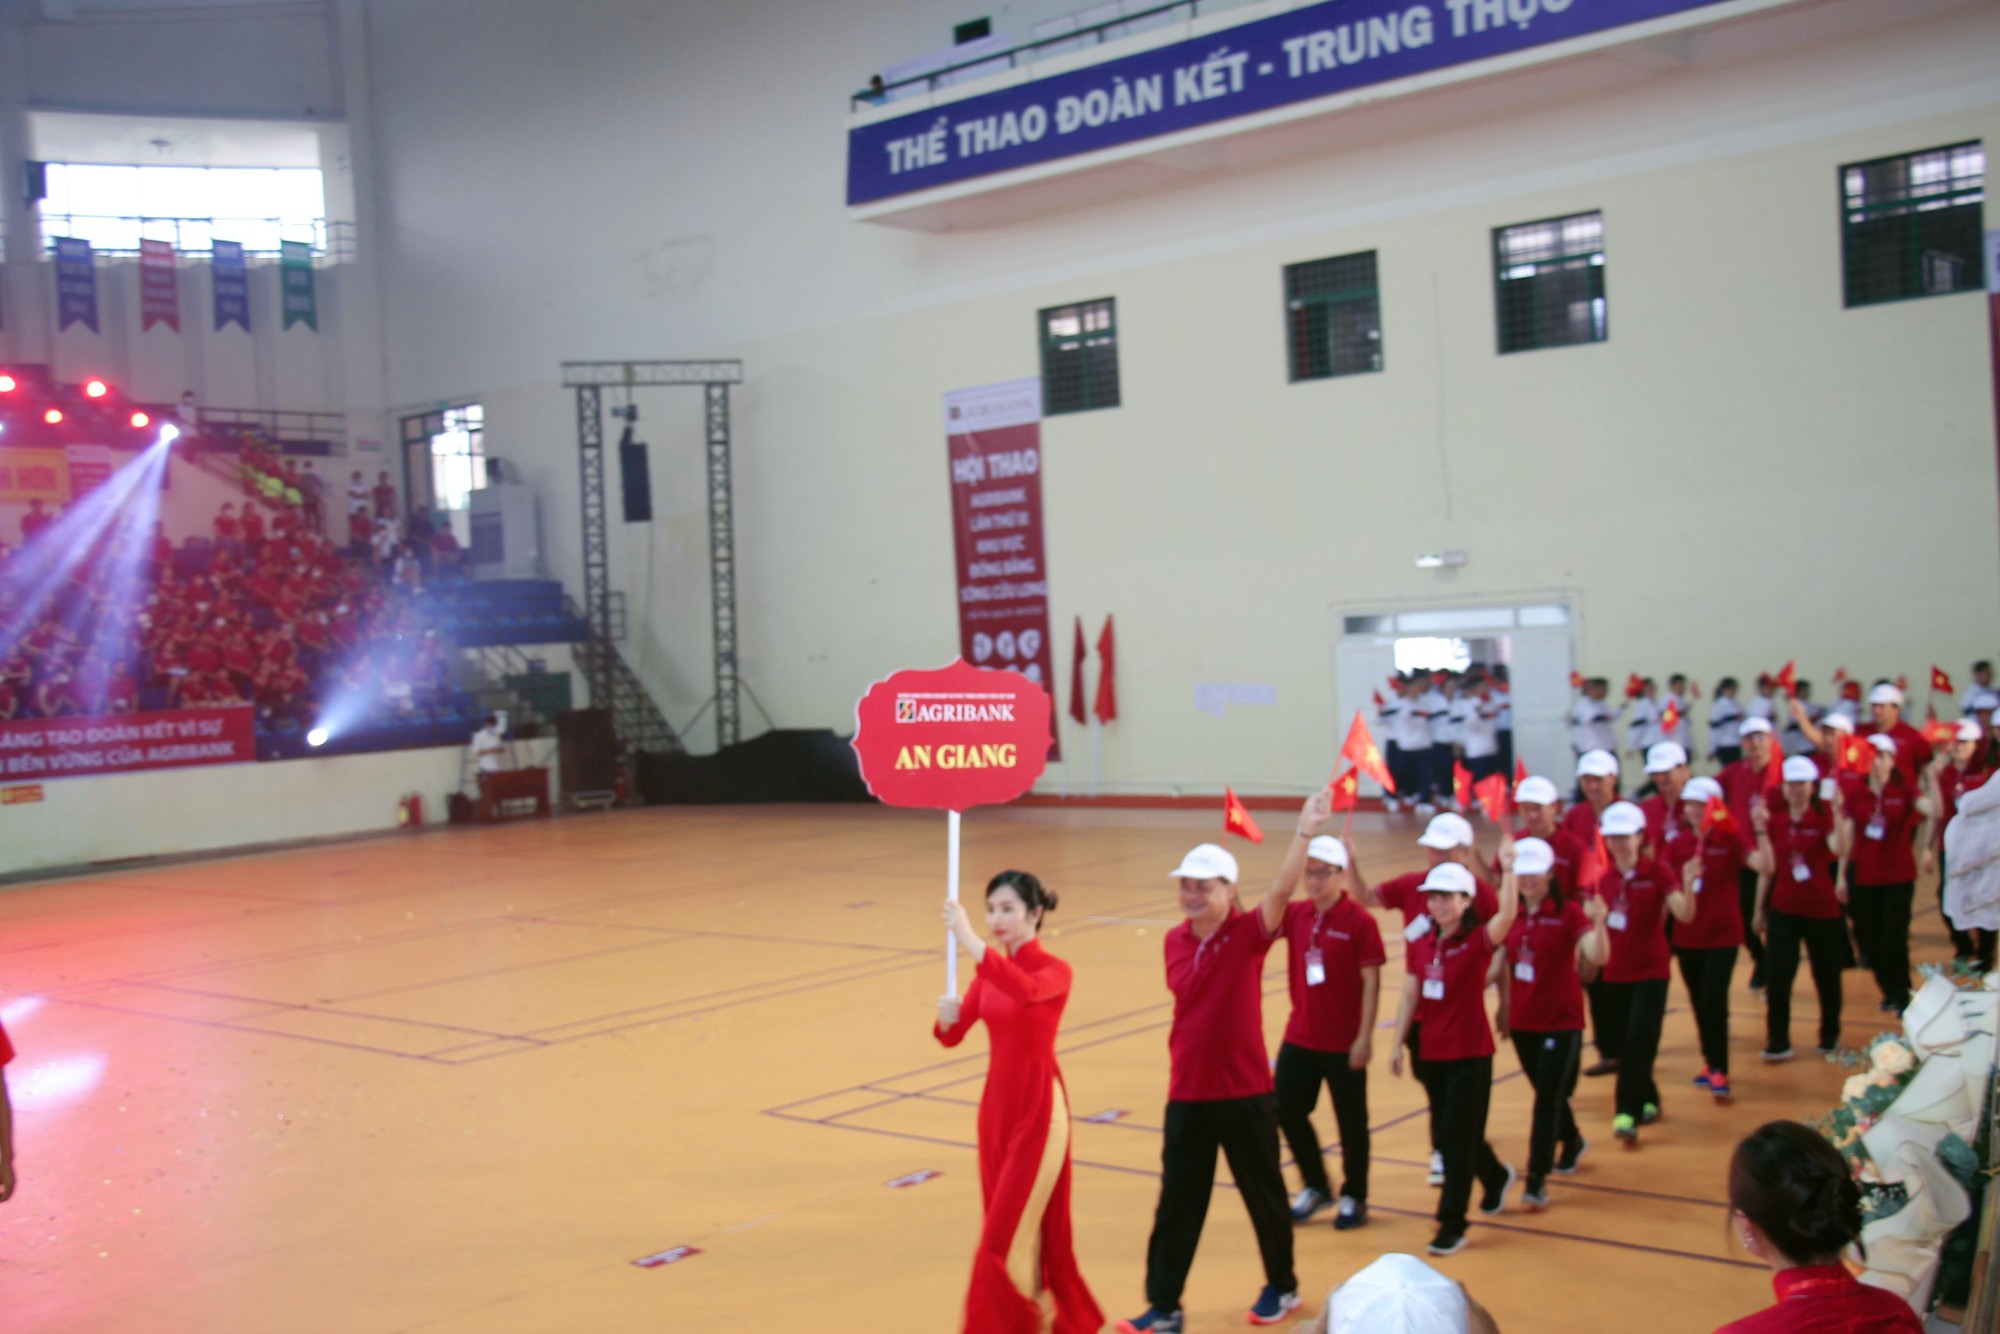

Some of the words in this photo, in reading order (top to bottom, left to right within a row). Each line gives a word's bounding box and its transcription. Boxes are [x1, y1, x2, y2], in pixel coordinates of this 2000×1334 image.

[886, 115, 949, 175] THỂ
[954, 105, 1048, 158] THAO
[1055, 75, 1164, 135] ĐOÀN
[1172, 46, 1249, 106] KẾT
[1282, 5, 1434, 79] TRUNG
[1445, 0, 1573, 38] TH
[988, 448, 1037, 479] THAO
[917, 703, 1016, 722] AGRIBANK
[895, 744, 931, 770] AN
[936, 743, 1017, 769] GIANG
